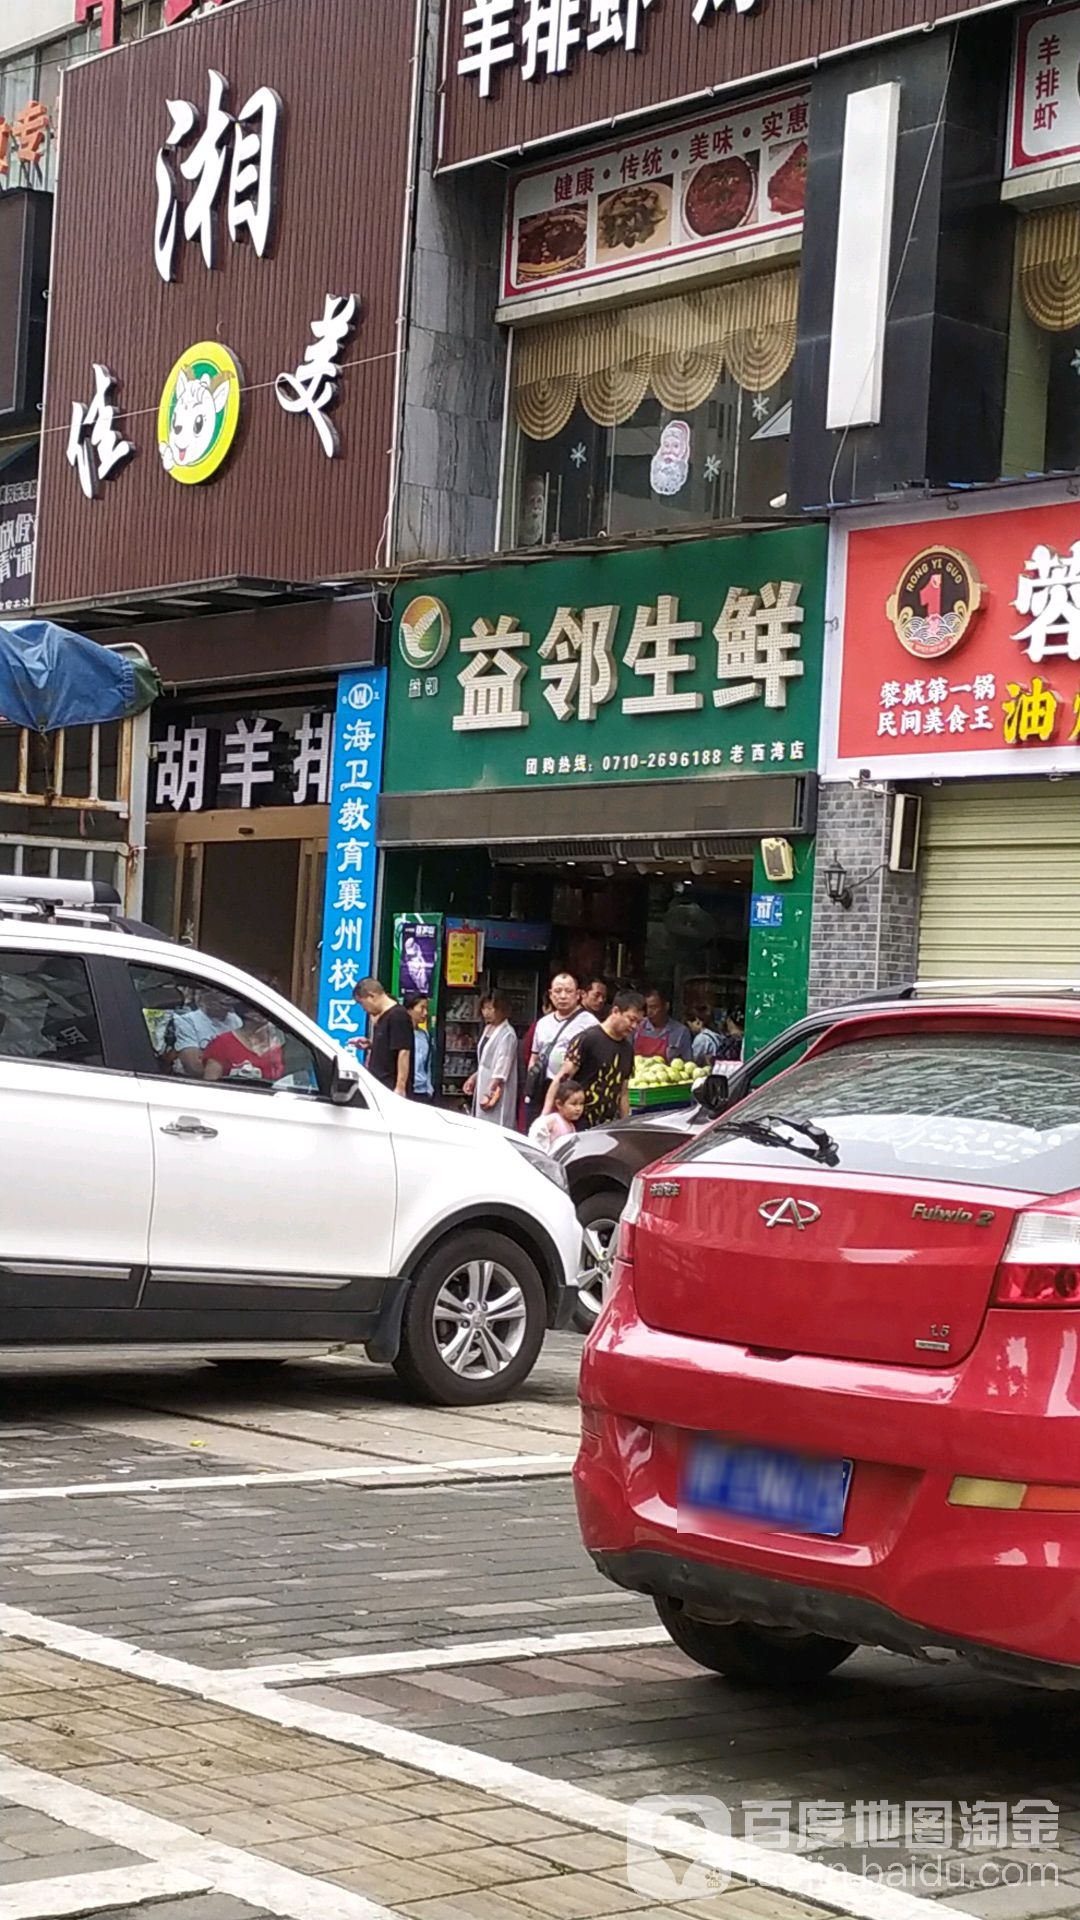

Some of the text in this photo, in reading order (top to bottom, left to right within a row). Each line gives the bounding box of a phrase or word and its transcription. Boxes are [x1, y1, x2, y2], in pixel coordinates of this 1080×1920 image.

[1032, 34, 1061, 131] 羊排虾
[154, 69, 282, 283] 湘
[452, 581, 804, 732] 益邻生鲜
[877, 706, 993, 737] 民间美食王
[880, 674, 995, 708] 蓉城第一锅
[1002, 678, 1080, 743] 油
[602, 749, 722, 771] 0710-2696188
[729, 741, 805, 763] 老西湾店
